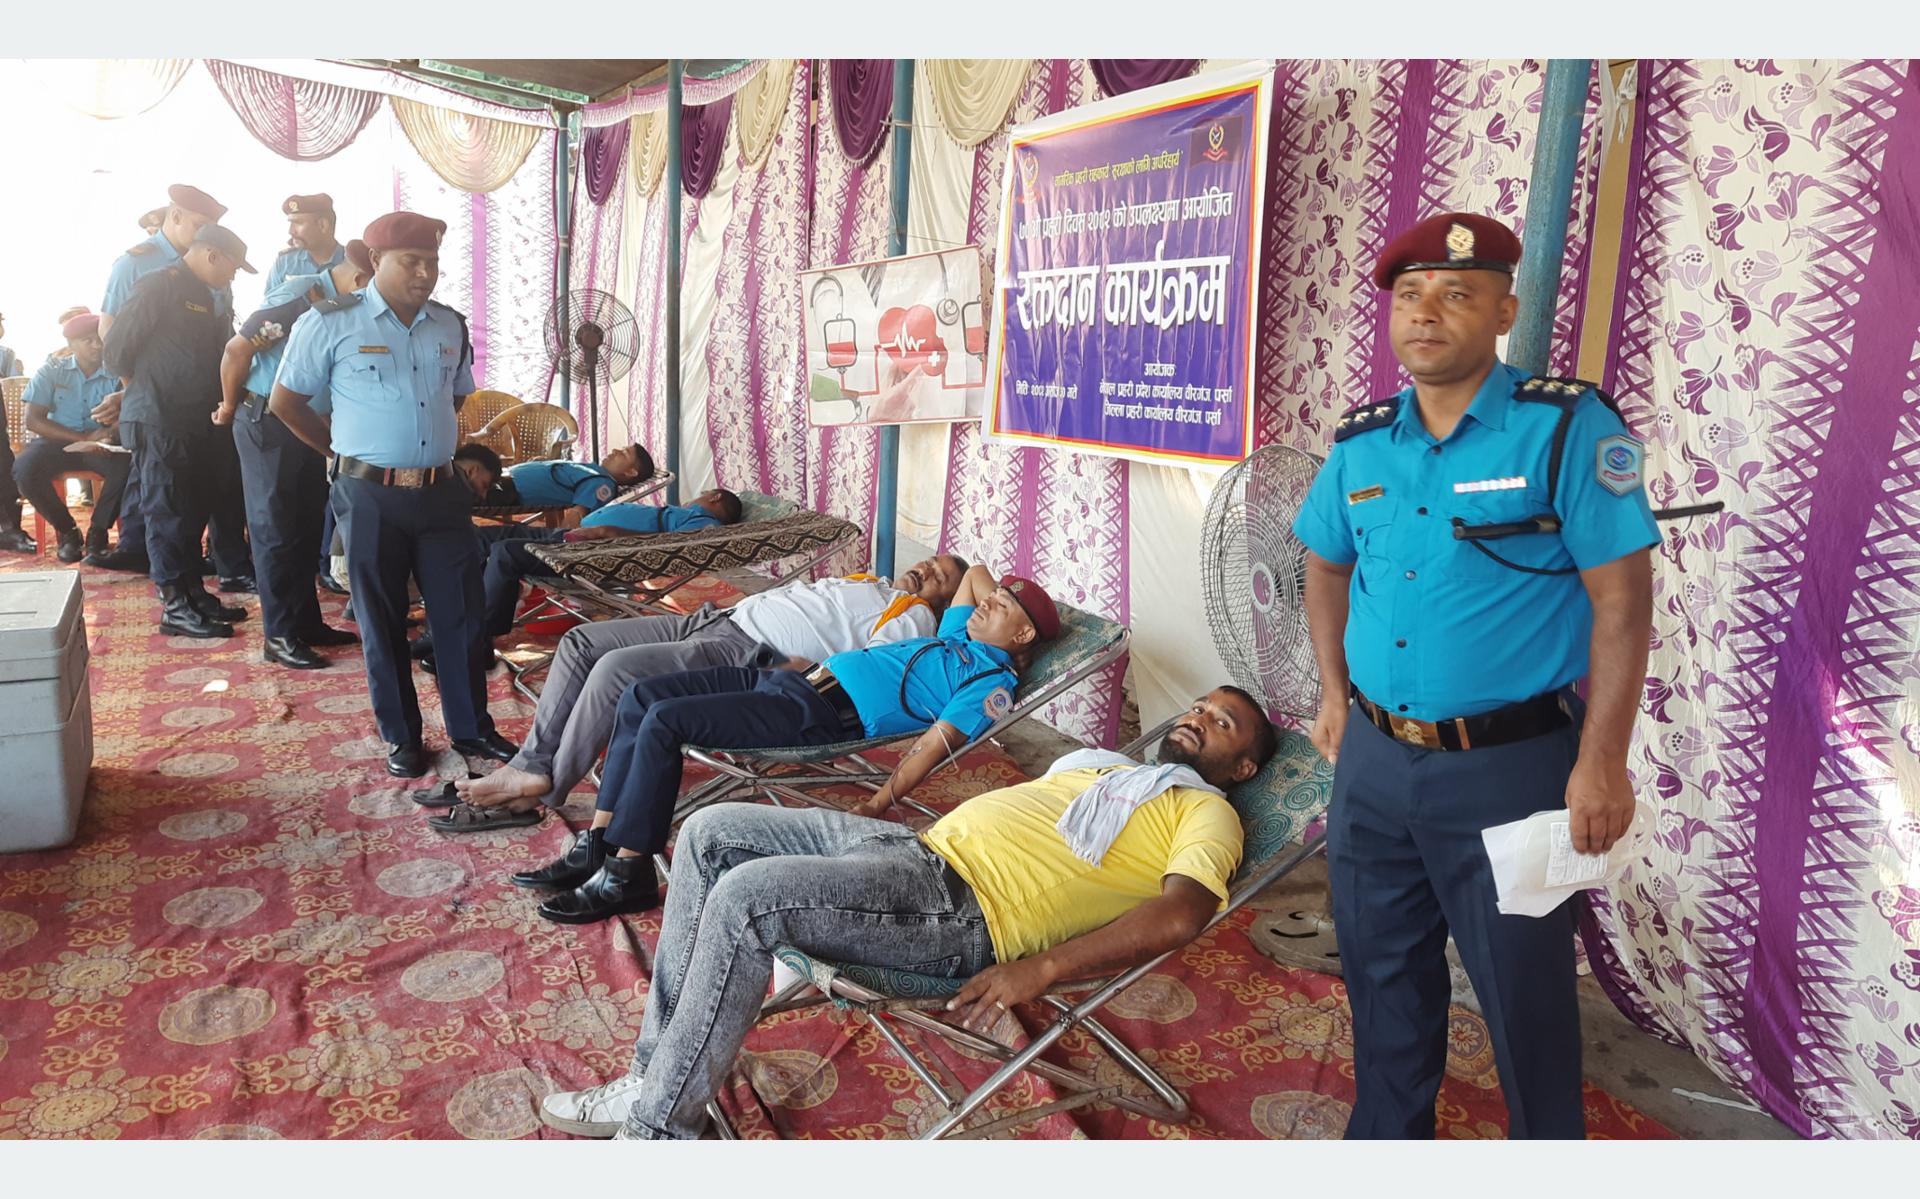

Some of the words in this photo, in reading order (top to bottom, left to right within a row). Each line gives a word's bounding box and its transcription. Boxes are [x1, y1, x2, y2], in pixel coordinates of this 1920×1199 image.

[1063, 208, 1086, 235] दिवस
[1113, 200, 1128, 228] को
[1183, 186, 1233, 220] आयोजित
[1016, 265, 1100, 331] रक्तदान
[1104, 239, 1231, 330] कार्यक्रम
